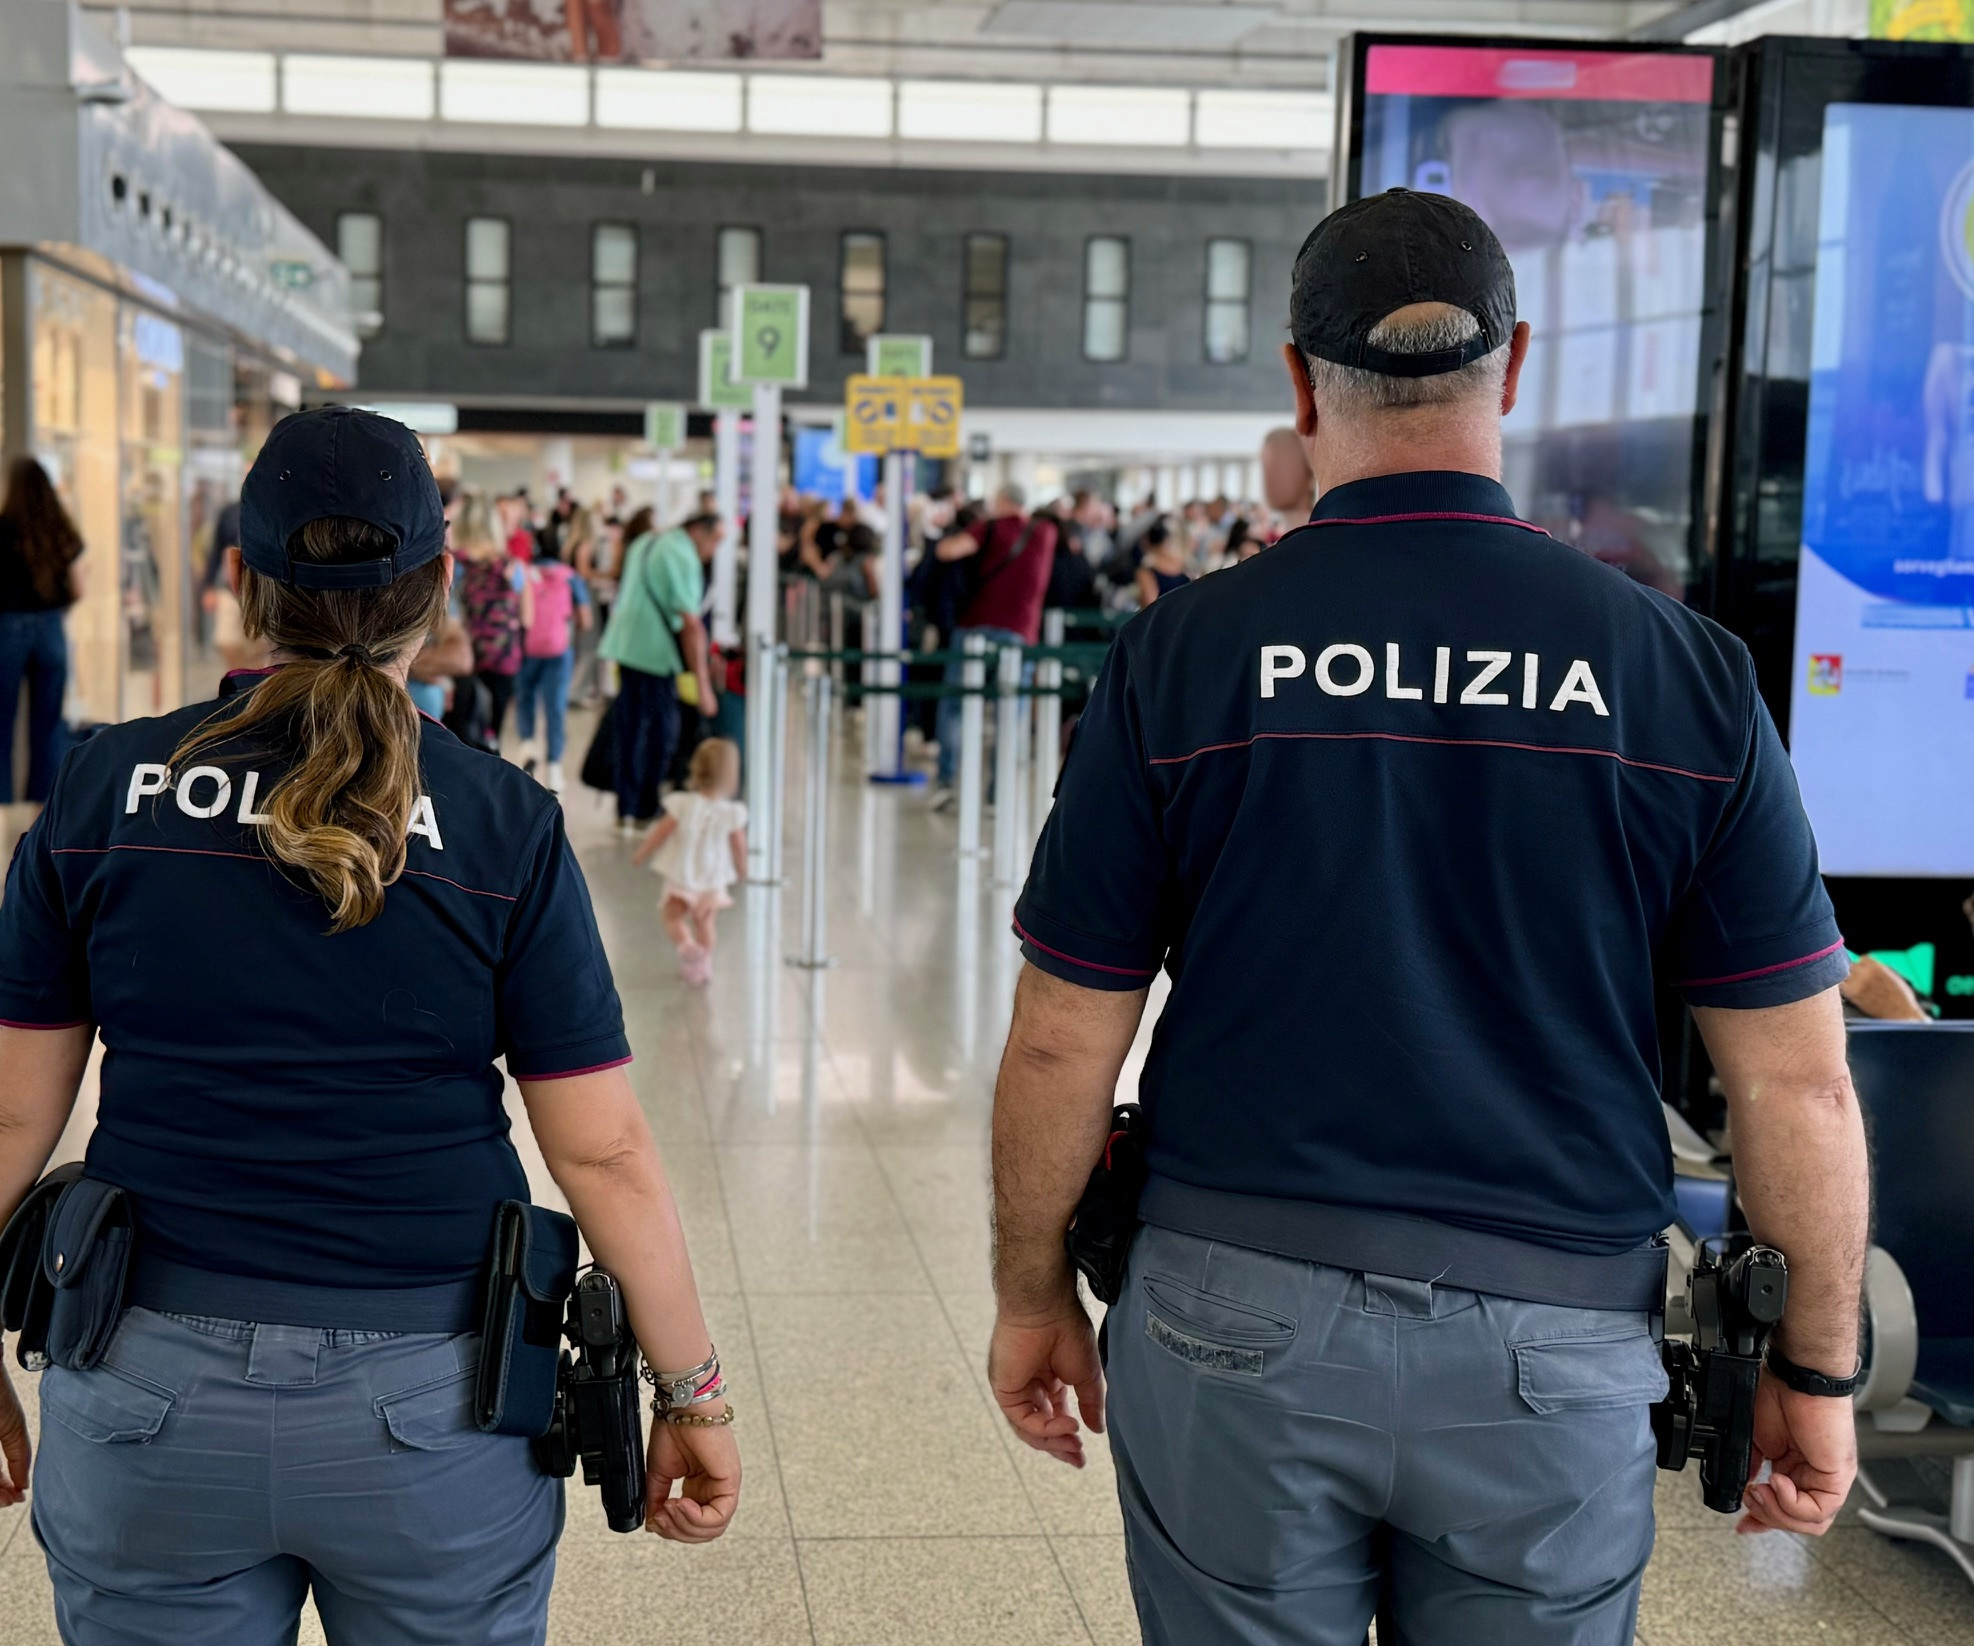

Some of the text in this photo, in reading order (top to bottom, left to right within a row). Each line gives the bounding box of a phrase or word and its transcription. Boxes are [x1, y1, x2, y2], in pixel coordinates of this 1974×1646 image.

[757, 325, 780, 360] 9
[1260, 643, 1610, 716] POLIZIA
[125, 763, 444, 850] POLA
